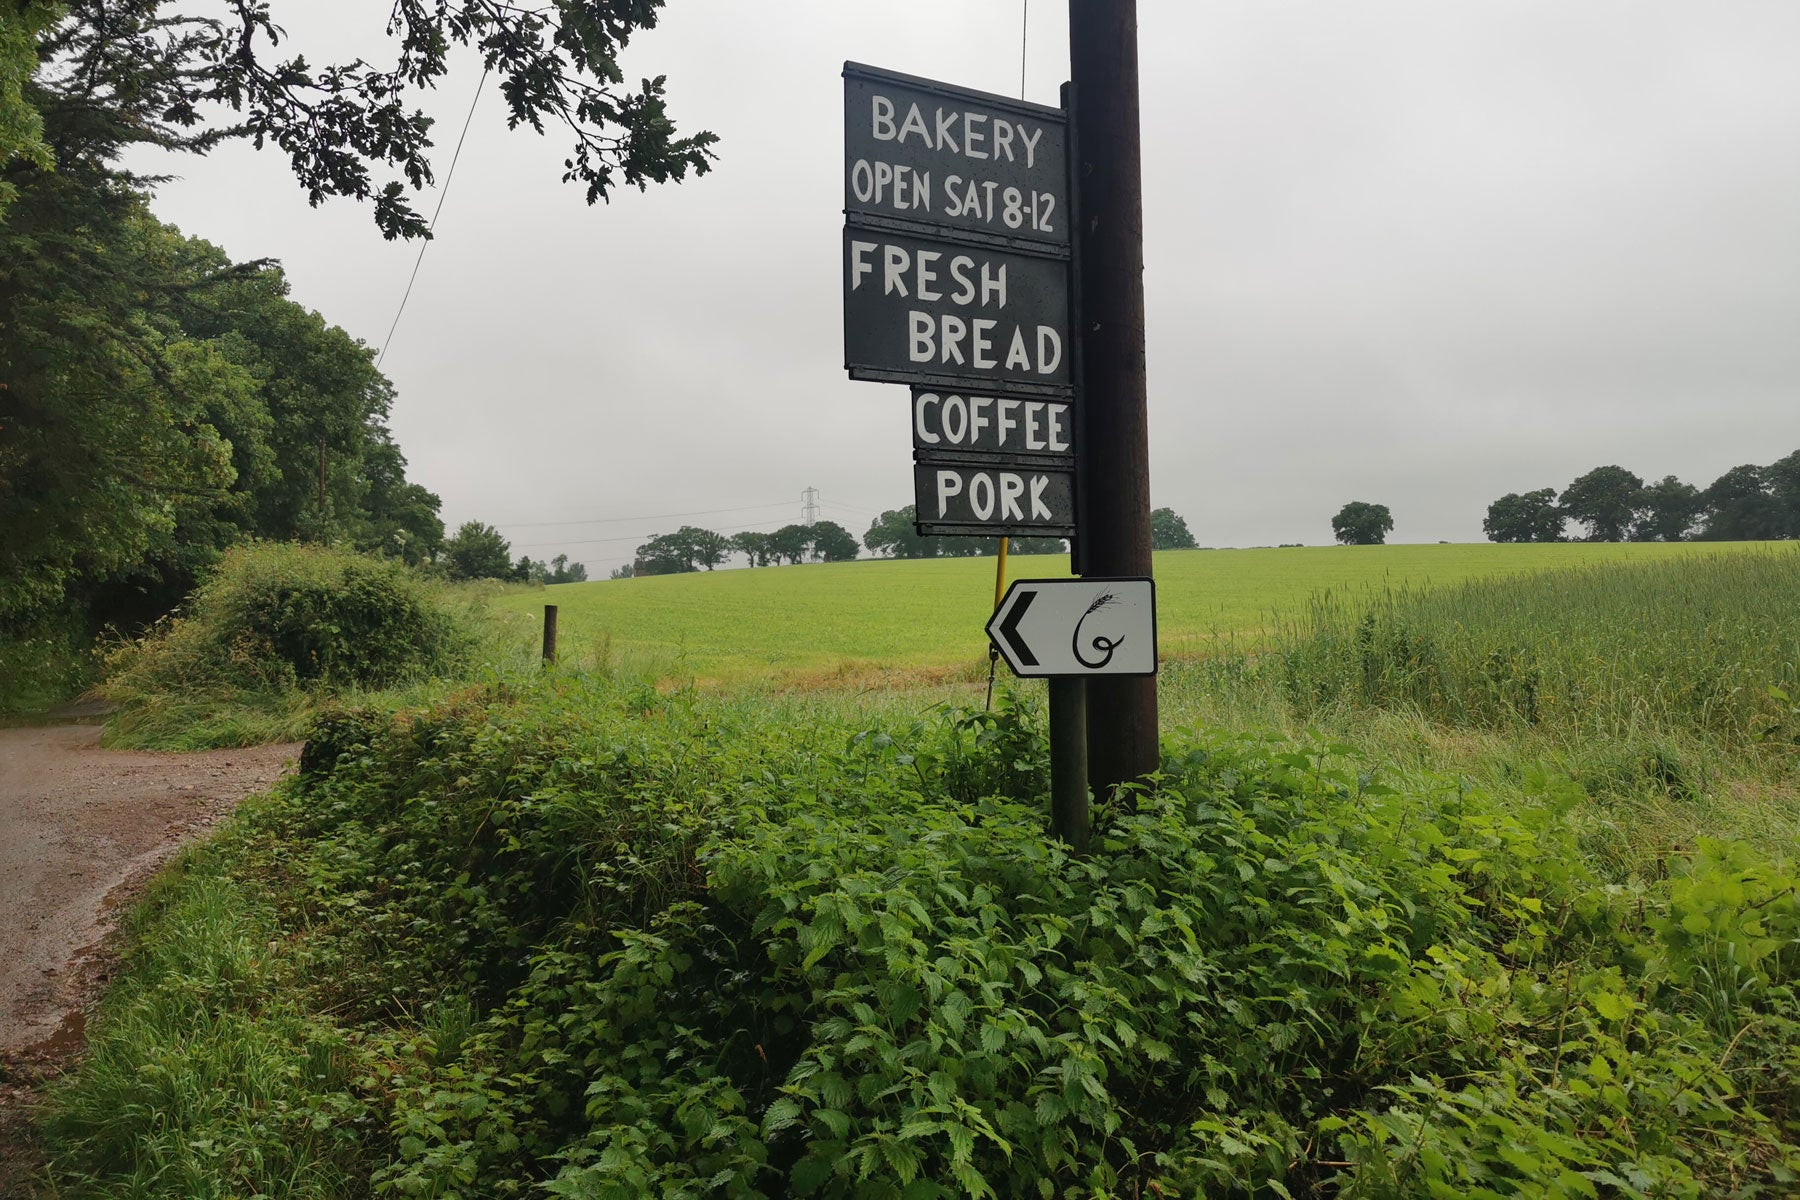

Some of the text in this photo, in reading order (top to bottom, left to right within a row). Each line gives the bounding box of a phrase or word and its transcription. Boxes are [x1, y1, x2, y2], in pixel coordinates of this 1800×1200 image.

[872, 95, 1043, 169] BAKERY
[851, 158, 1056, 233] OPEN SAT 8-12
[851, 240, 1007, 310] FRESH
[908, 310, 1062, 375] BREAD
[915, 393, 1070, 452] COFFEE
[936, 470, 1052, 521] PORK
